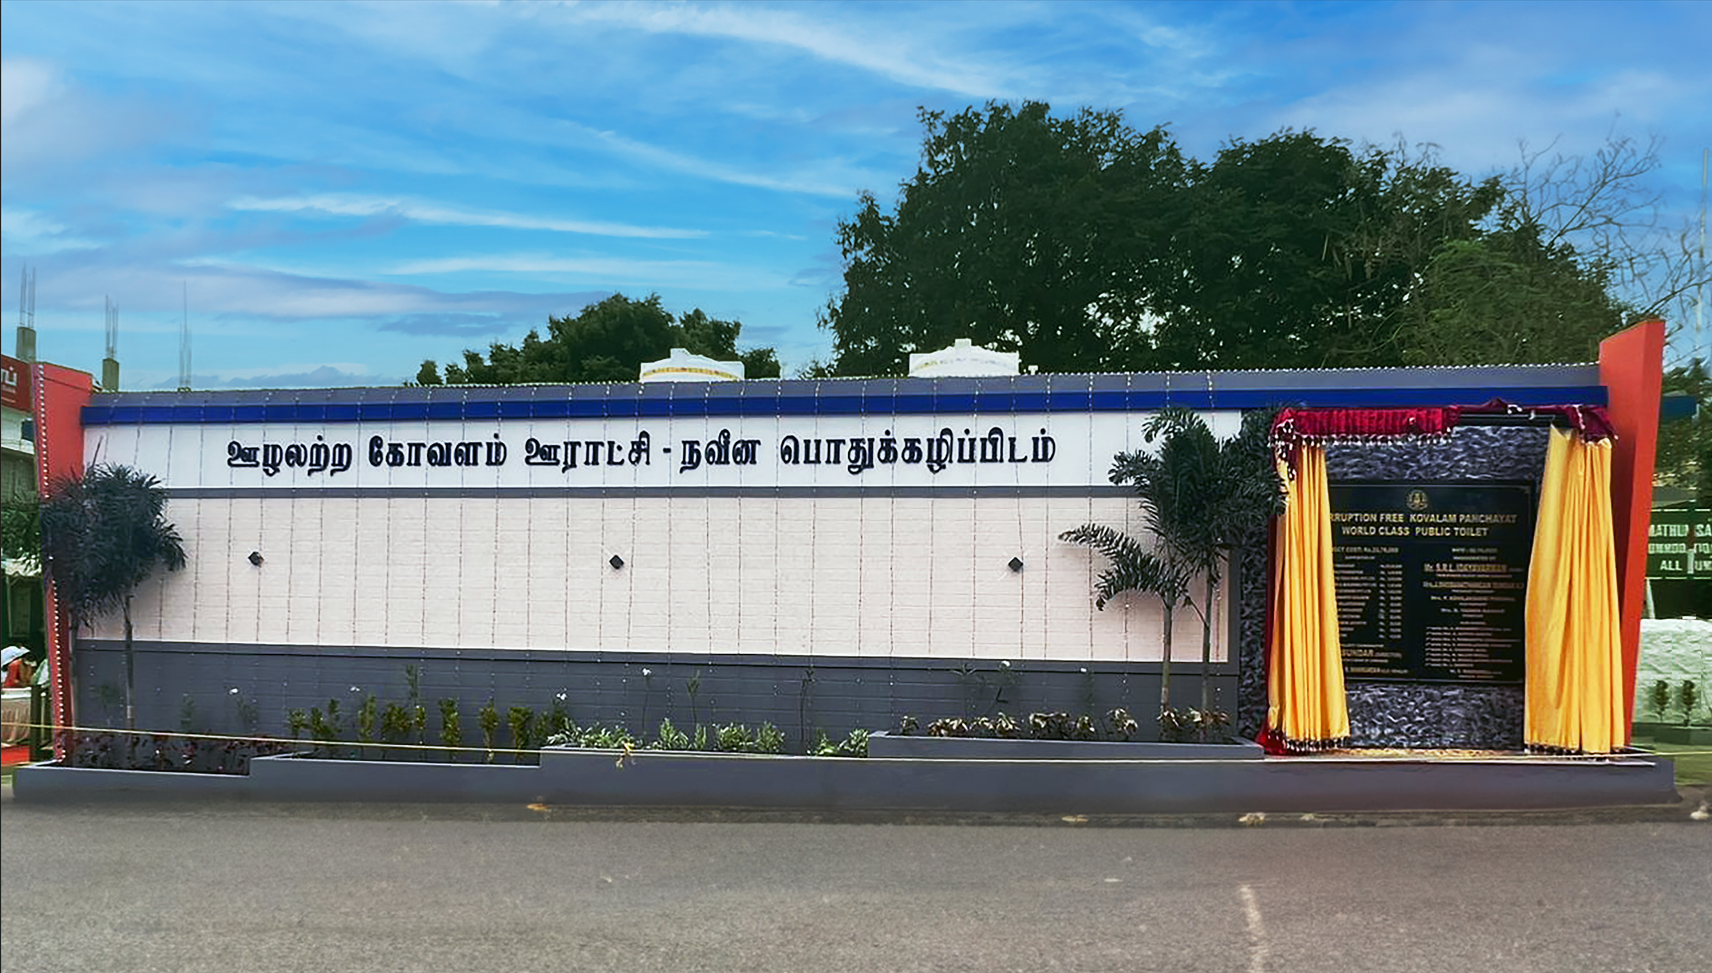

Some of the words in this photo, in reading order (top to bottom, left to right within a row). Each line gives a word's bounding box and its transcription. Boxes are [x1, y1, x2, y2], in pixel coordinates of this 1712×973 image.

[226, 434, 353, 477] ஊழலற்ற
[368, 431, 508, 468] கோவளம்
[524, 430, 651, 474] ஊராட்சி
[679, 428, 761, 474] நவீன
[780, 426, 1056, 475] பொதுக்கழிப்பிடம்
[1379, 513, 1404, 523] FREE
[1409, 513, 1457, 523] KOVALAM
[1459, 513, 1517, 523] PANCHAYAT
[1342, 526, 1376, 536] WORLD
[1378, 526, 1410, 536] CLASS
[1415, 526, 1451, 536] PUBLIC
[1453, 526, 1488, 536] TOILET
[1659, 559, 1683, 571] ALL
